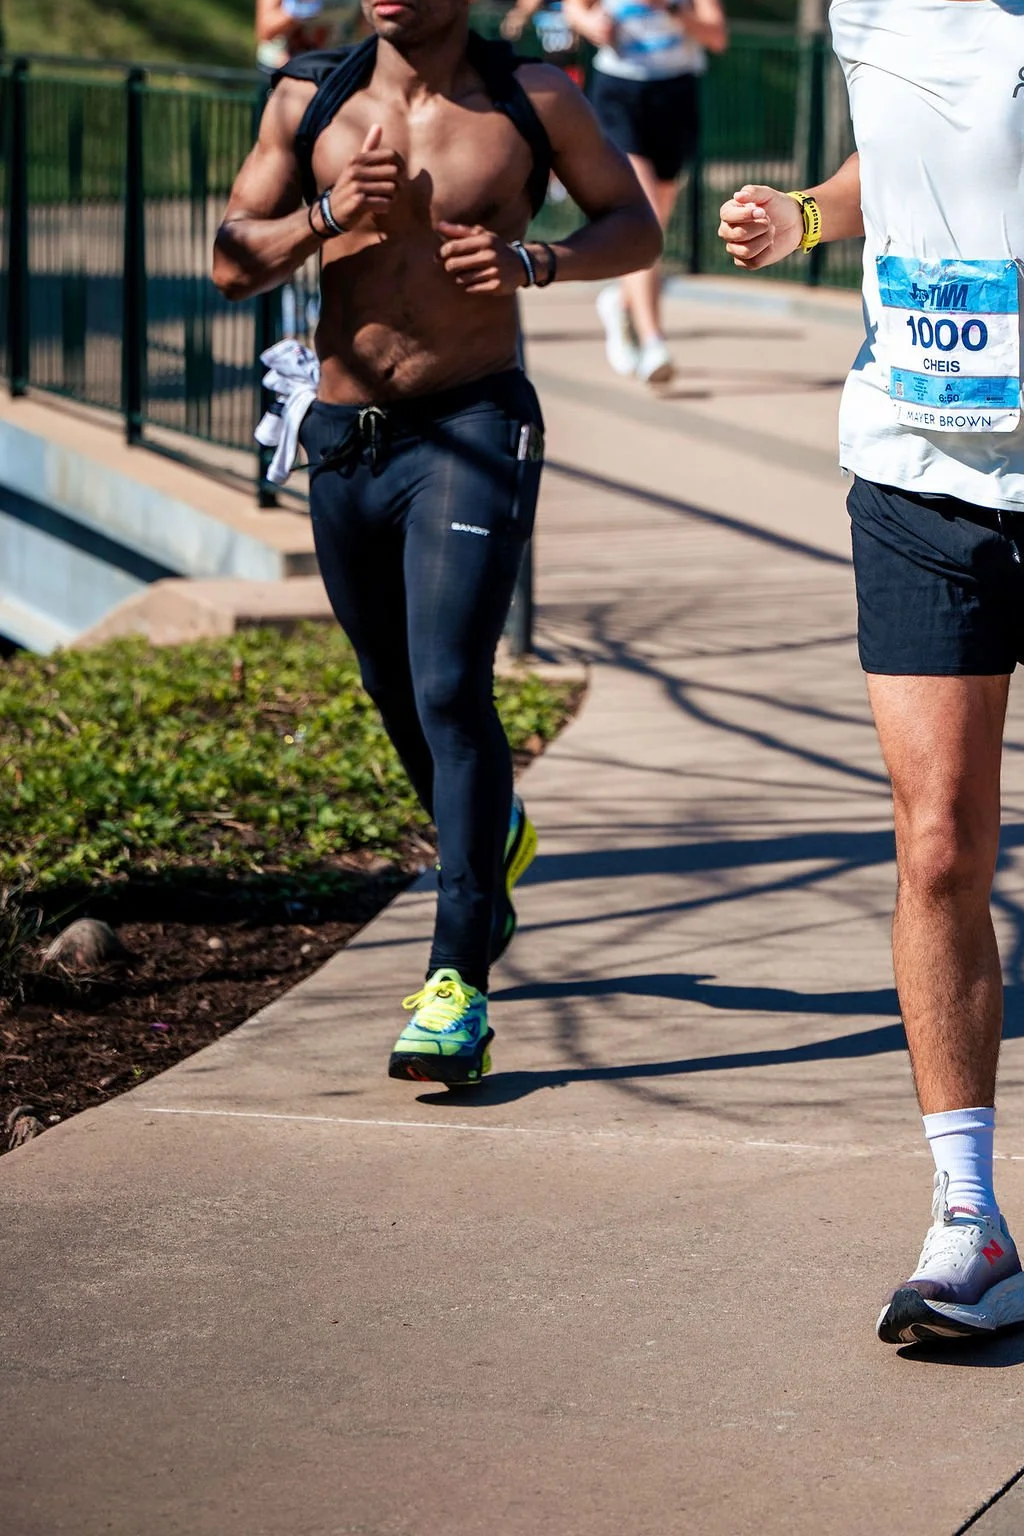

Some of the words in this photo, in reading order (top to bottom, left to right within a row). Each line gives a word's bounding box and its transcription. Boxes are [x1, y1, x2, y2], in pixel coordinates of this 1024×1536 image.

[929, 284, 968, 307] TWM
[906, 315, 988, 352] 1000
[923, 358, 960, 373] CHEIS
[944, 384, 953, 392] A
[938, 394, 960, 404] 6:50
[907, 411, 935, 425] MAYER
[939, 415, 992, 427] BROWN
